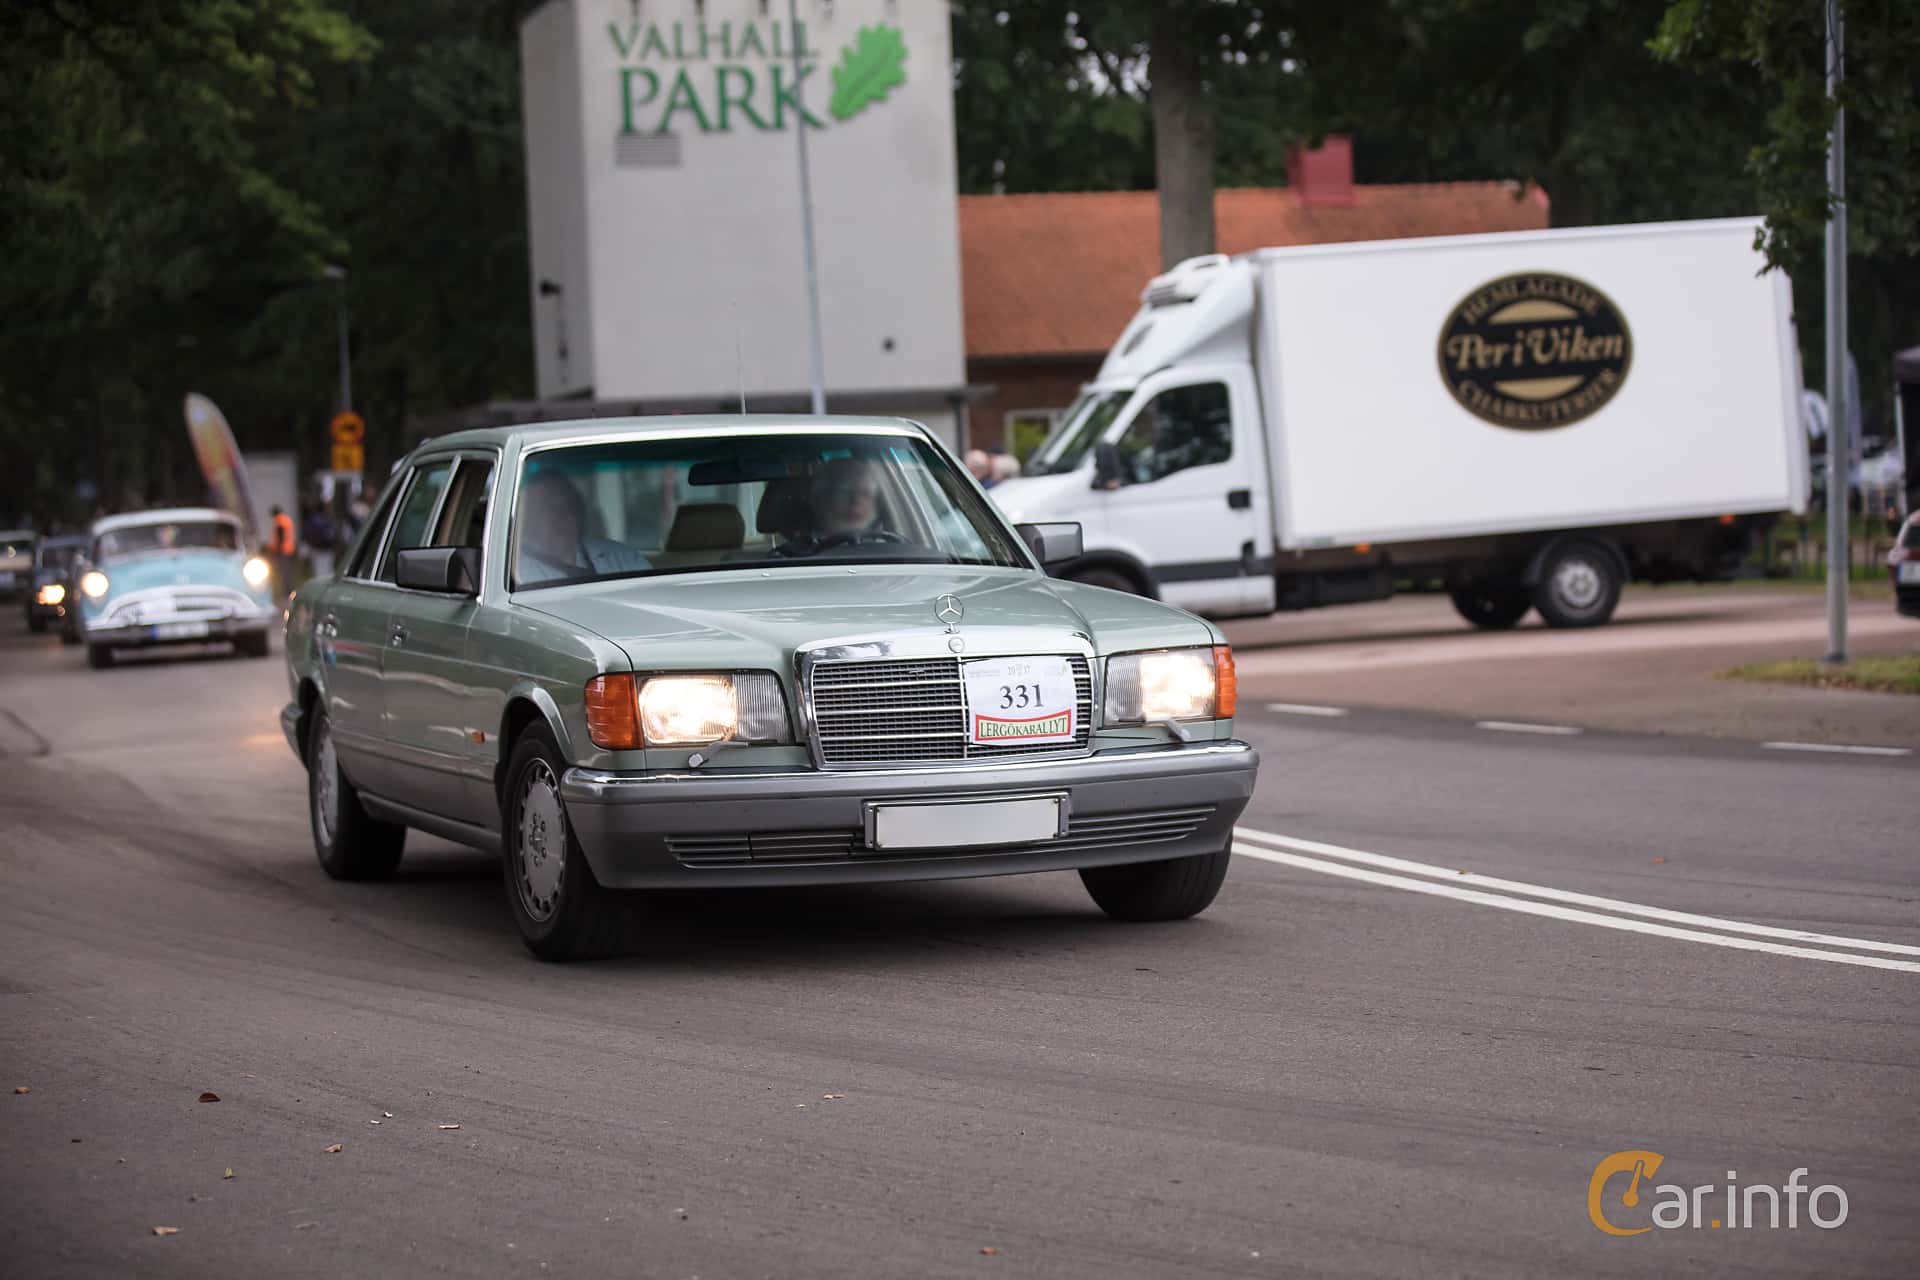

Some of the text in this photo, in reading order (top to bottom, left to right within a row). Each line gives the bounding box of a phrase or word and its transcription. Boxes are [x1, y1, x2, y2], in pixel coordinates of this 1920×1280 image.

[607, 20, 820, 60] VALHALL
[618, 64, 826, 133] PARK
[1447, 333, 1509, 369] Per
[1527, 325, 1623, 365] Viken
[1000, 684, 1044, 709] 331
